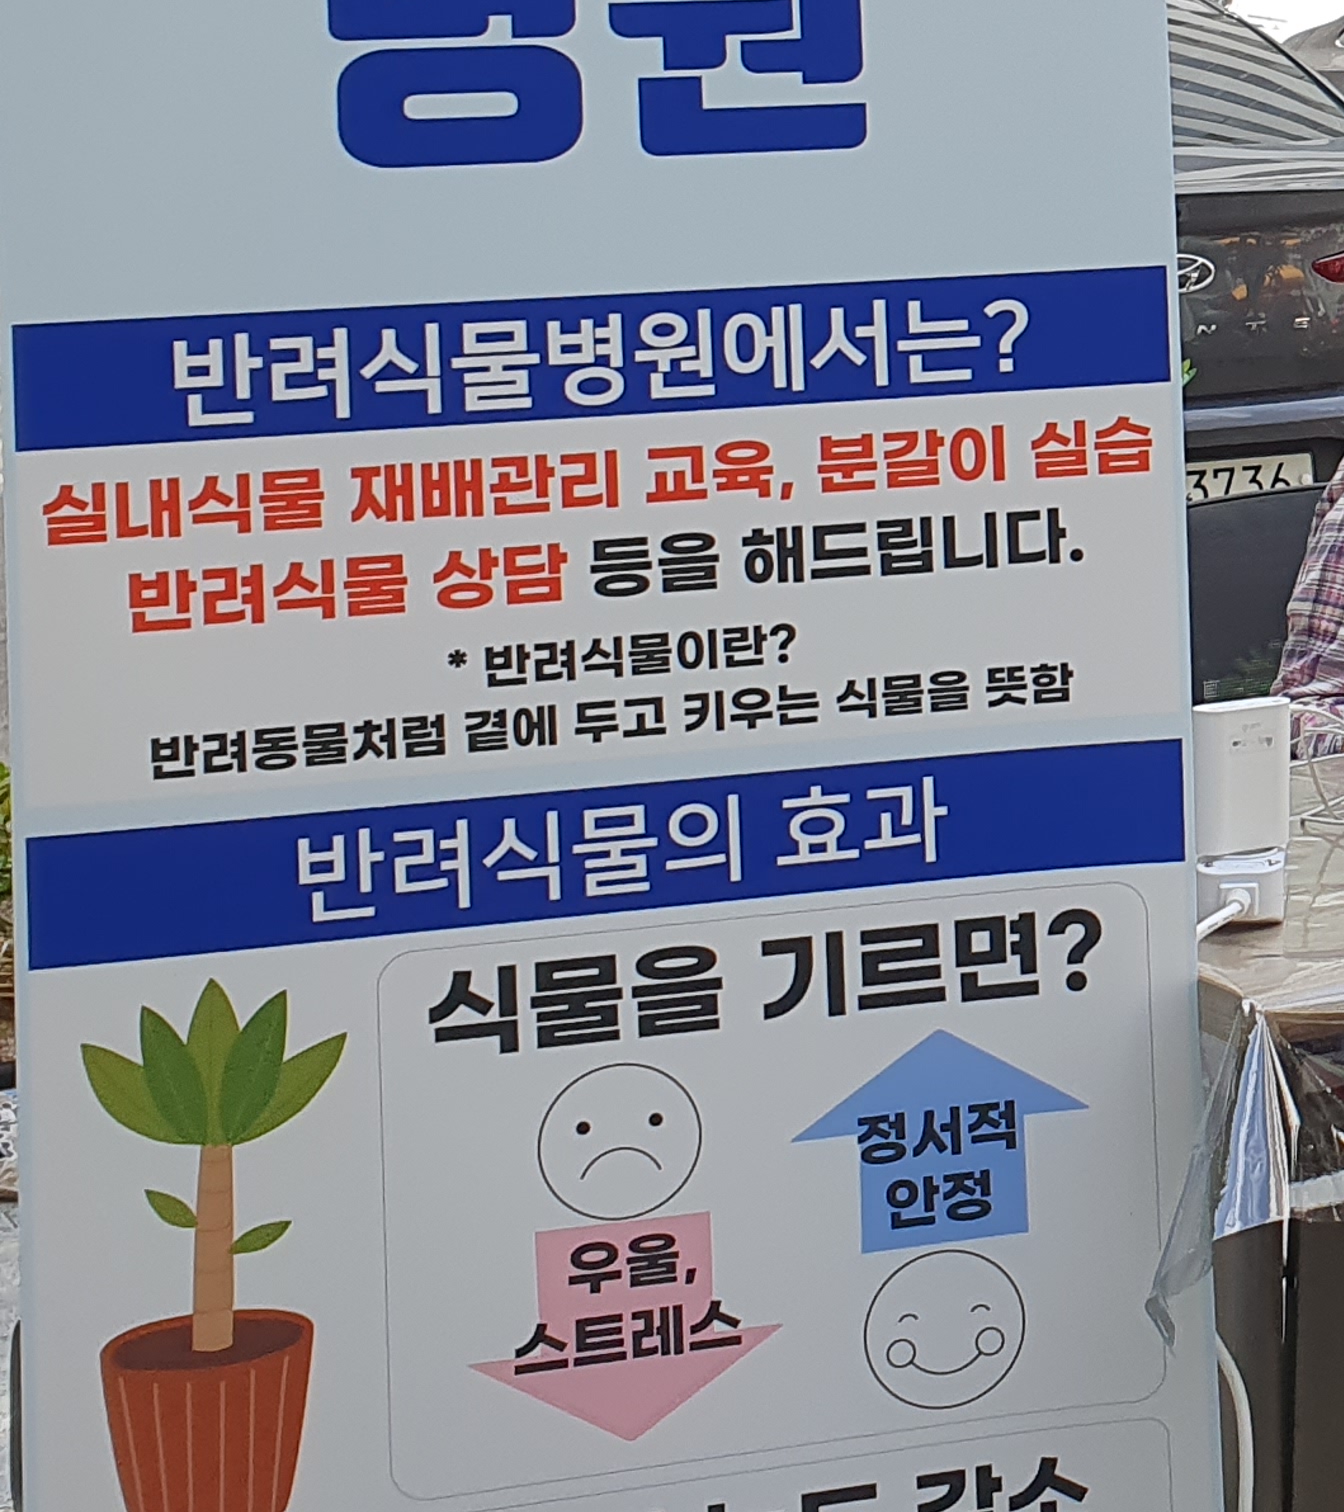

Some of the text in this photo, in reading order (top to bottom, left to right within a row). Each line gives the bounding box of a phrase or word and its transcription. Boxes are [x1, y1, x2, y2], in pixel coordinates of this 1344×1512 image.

[173, 299, 1029, 427] 반려식물병원에서는?
[44, 417, 1153, 546] 실내식물 재배관리 교육, 분갈이 실습
[130, 507, 1084, 633] 반려식물 상담 등을 해드립니다.
[150, 662, 1074, 780] 반려동물처럼 곁에 두고 키우는 식물을 뜻함
[297, 775, 948, 923] 반려식물의 효과
[428, 908, 1102, 1054] 식물을 기르면?
[856, 1099, 1017, 1165] 정서적
[885, 1168, 993, 1231] 안정
[568, 1233, 697, 1295] 우울,
[514, 1300, 743, 1376] 스트레스
